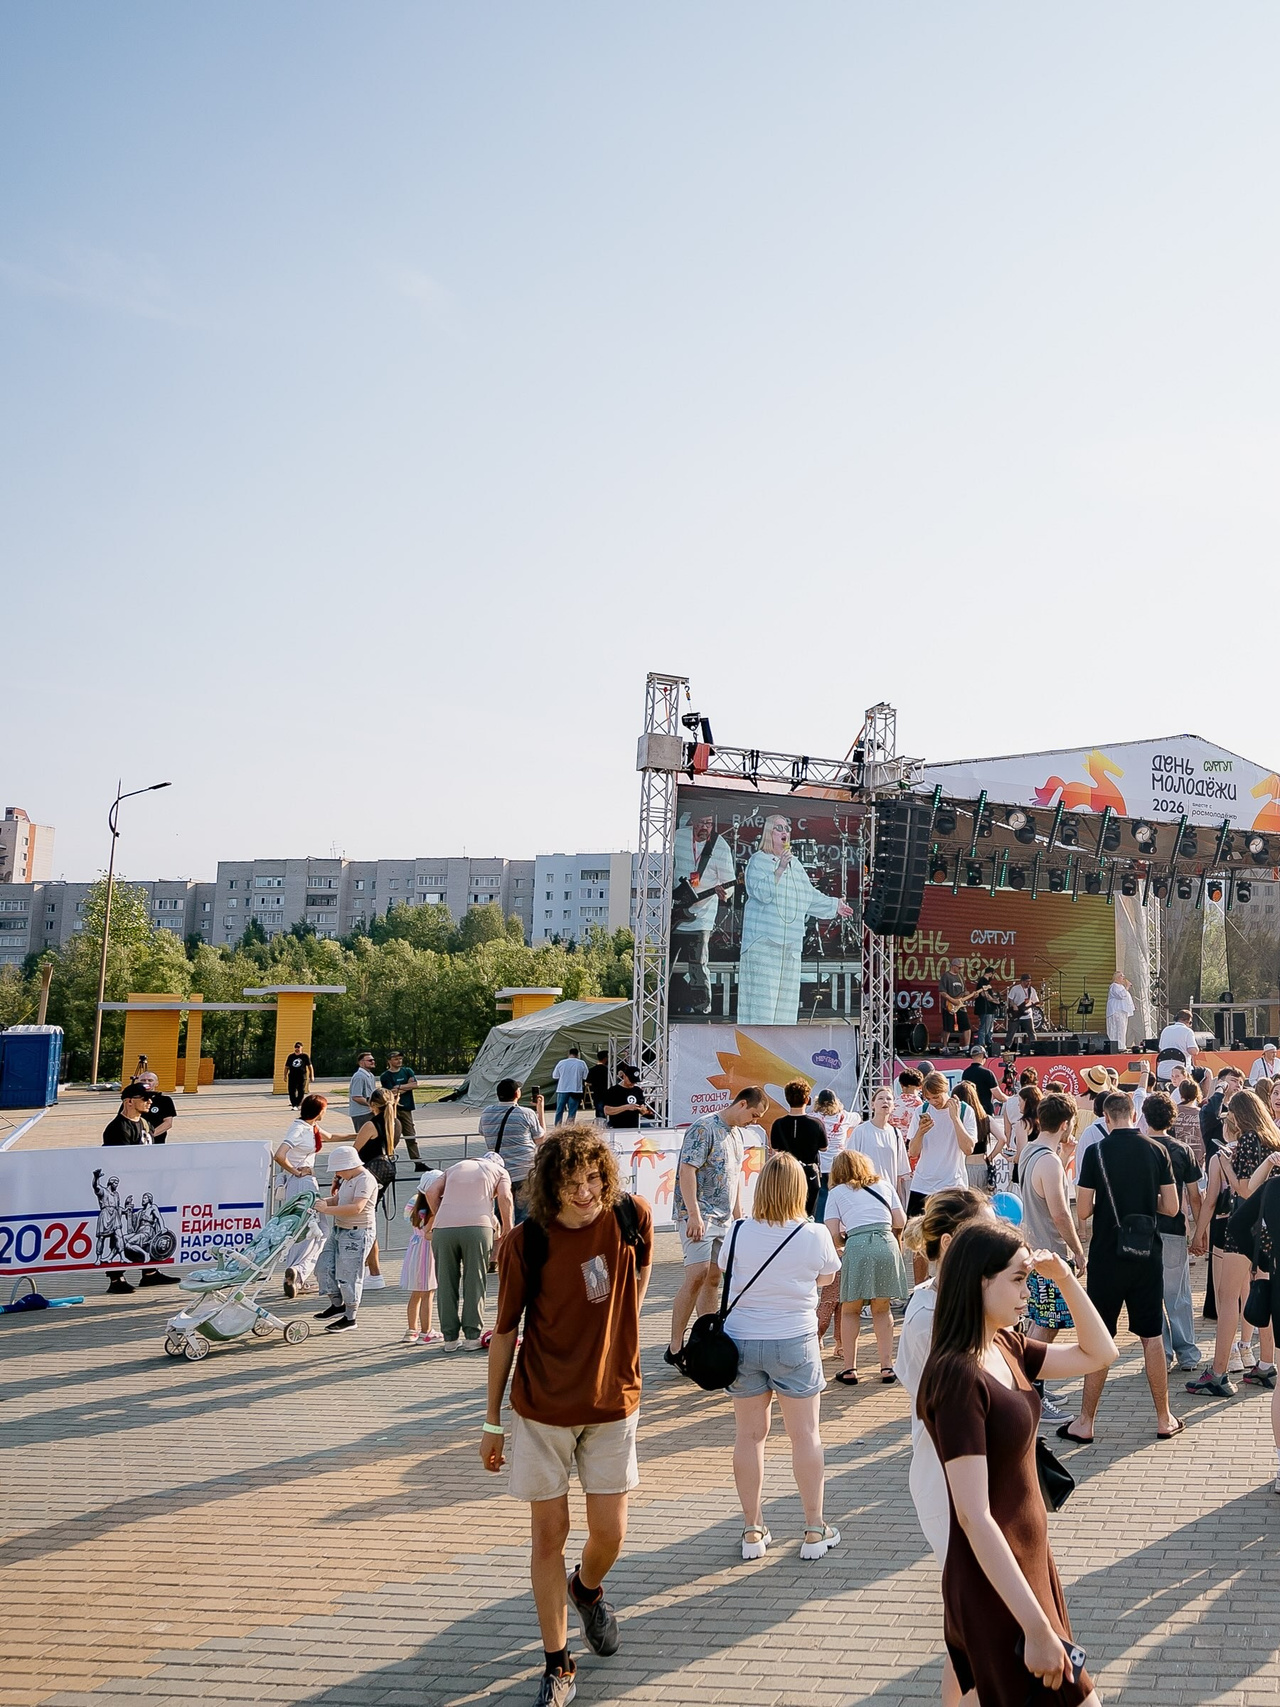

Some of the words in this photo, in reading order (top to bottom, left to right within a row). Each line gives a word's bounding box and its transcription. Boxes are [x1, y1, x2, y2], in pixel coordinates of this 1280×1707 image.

[1152, 755, 1195, 776] ДЕНЬ
[1203, 760, 1233, 772] СУРГУТ
[1152, 773, 1237, 801] МОЛОДЁЖИ
[1152, 798, 1185, 814] 2026
[970, 930, 1017, 945] СУРГУТ
[691, 1091, 728, 1103] СЕГОДНЯ
[691, 1105, 698, 1115] Я
[182, 1204, 213, 1218] ГОД
[181, 1217, 262, 1234] ЕДИНСТВА
[181, 1233, 254, 1248] НАРОДОВ
